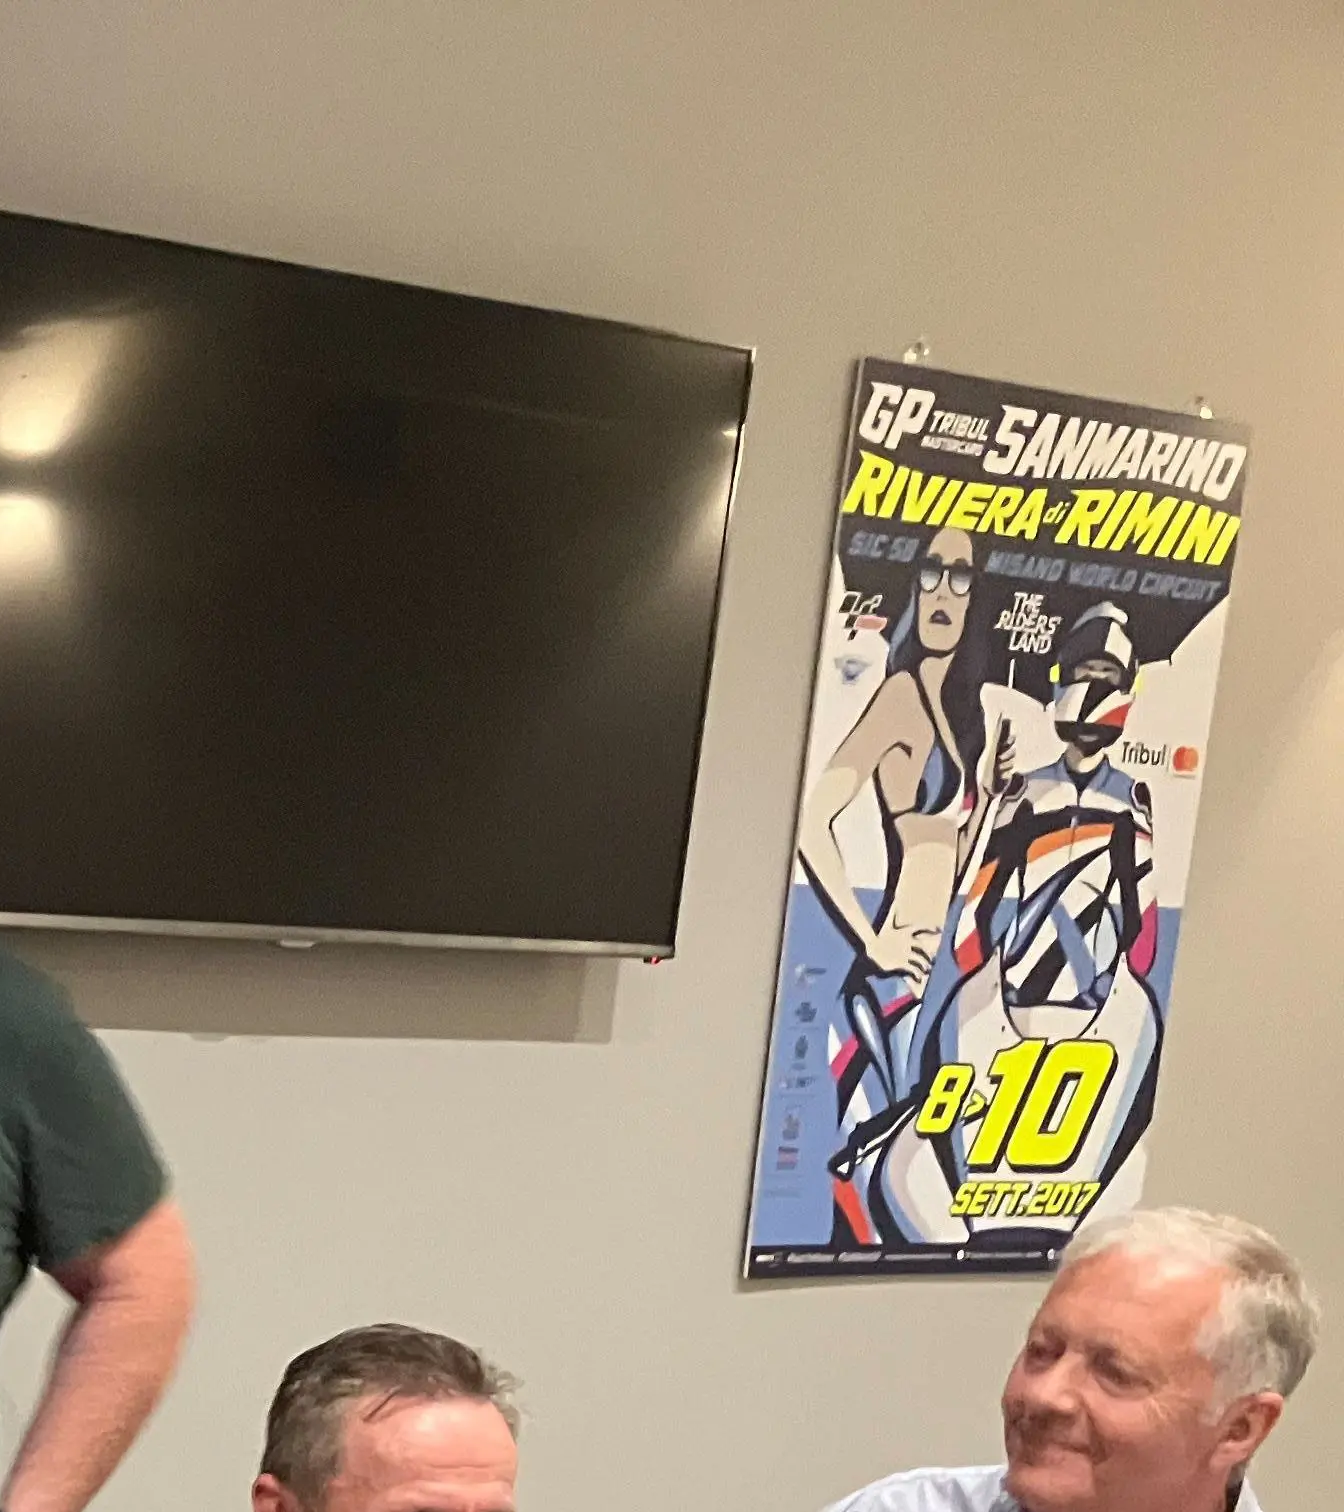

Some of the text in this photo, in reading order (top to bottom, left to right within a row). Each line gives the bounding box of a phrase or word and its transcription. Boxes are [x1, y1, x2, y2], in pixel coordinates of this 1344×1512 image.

[859, 381, 936, 450] GP
[929, 410, 990, 441] TRIBUL
[983, 404, 1247, 501] SANMARINO
[842, 450, 1242, 565] RIVIERA di RIMINI
[1013, 591, 1046, 615] THE
[1008, 631, 1052, 655] LAND
[1121, 740, 1167, 767] Tribul
